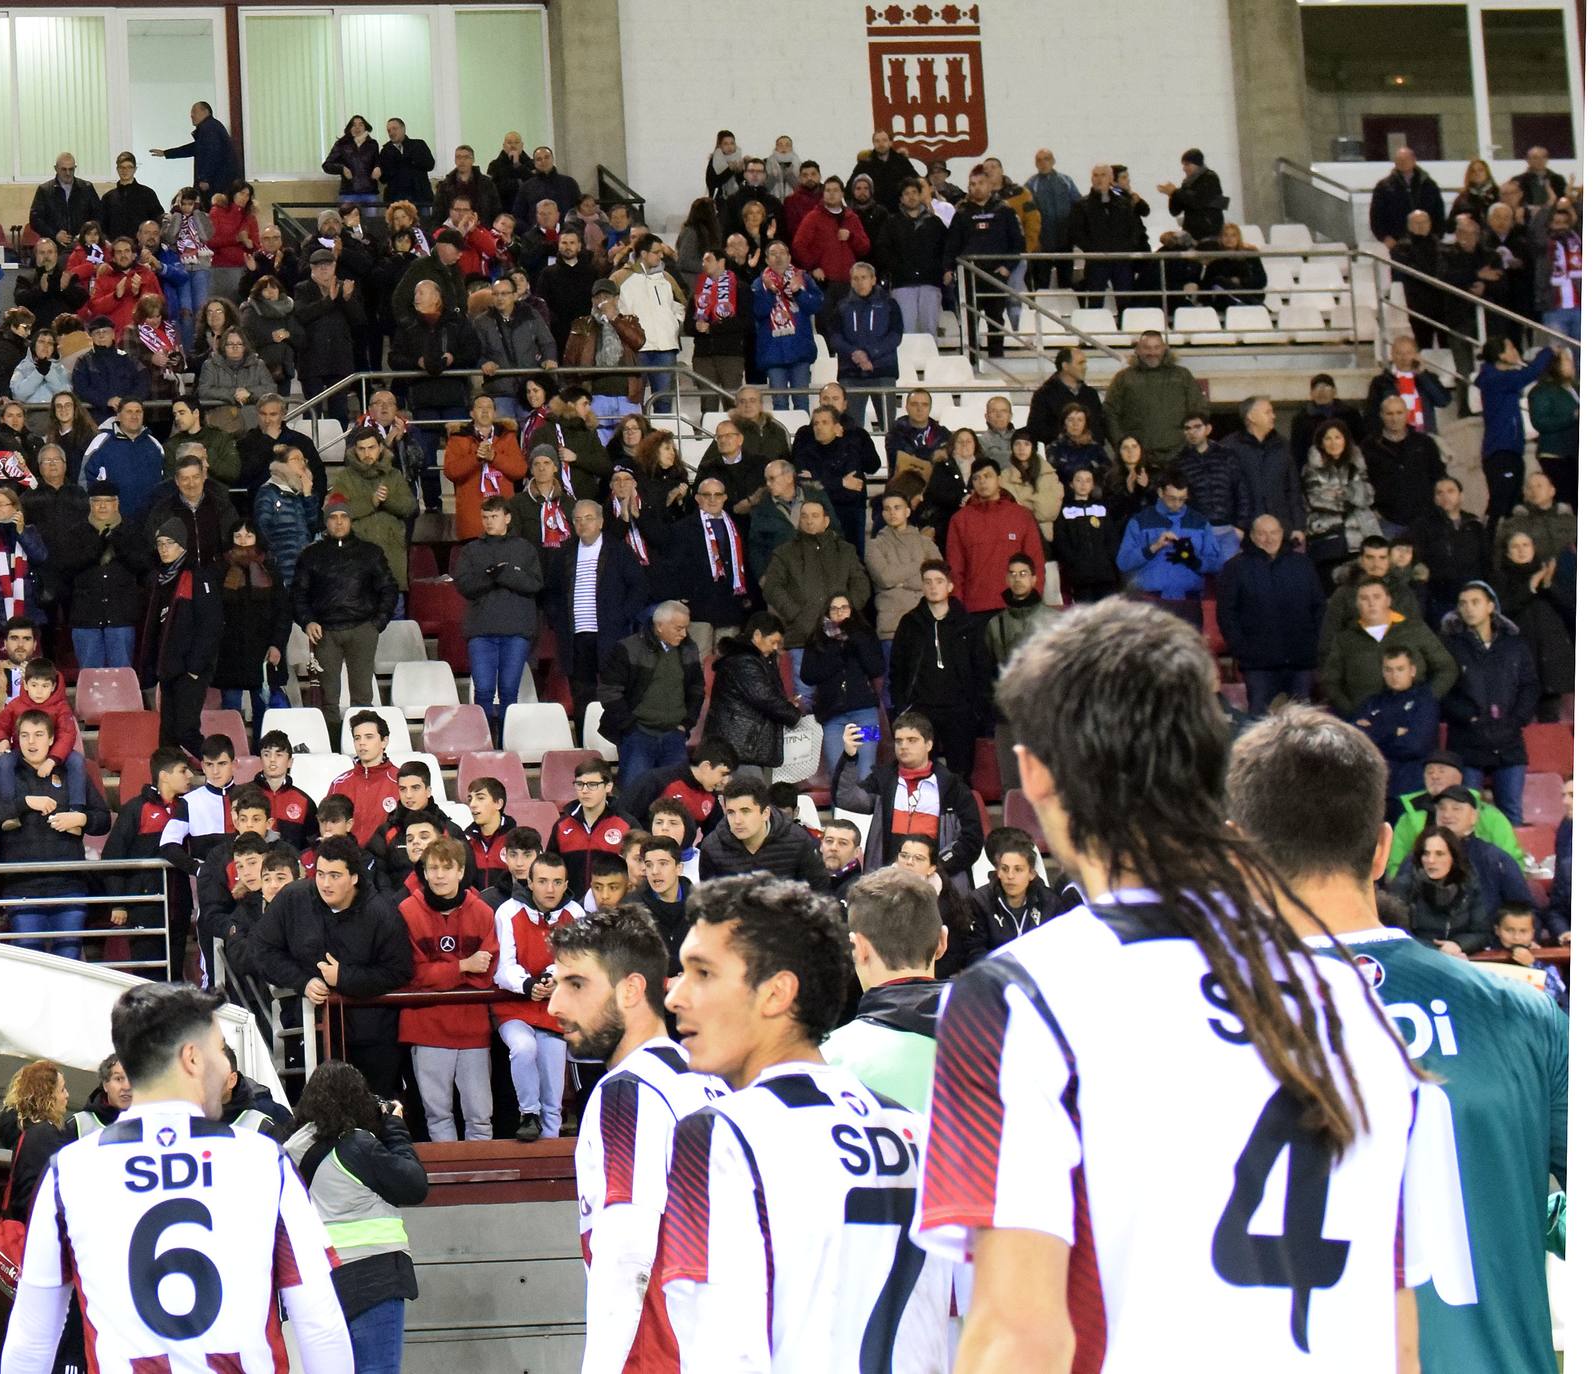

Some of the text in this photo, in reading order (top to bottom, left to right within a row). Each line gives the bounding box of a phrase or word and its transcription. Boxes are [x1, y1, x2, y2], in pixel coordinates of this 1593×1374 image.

[1383, 999, 1458, 1060] Di
[124, 1150, 213, 1194] SDi
[1211, 1083, 1351, 1354] 4
[128, 1197, 223, 1341] 6
[844, 1186, 927, 1374] 7
